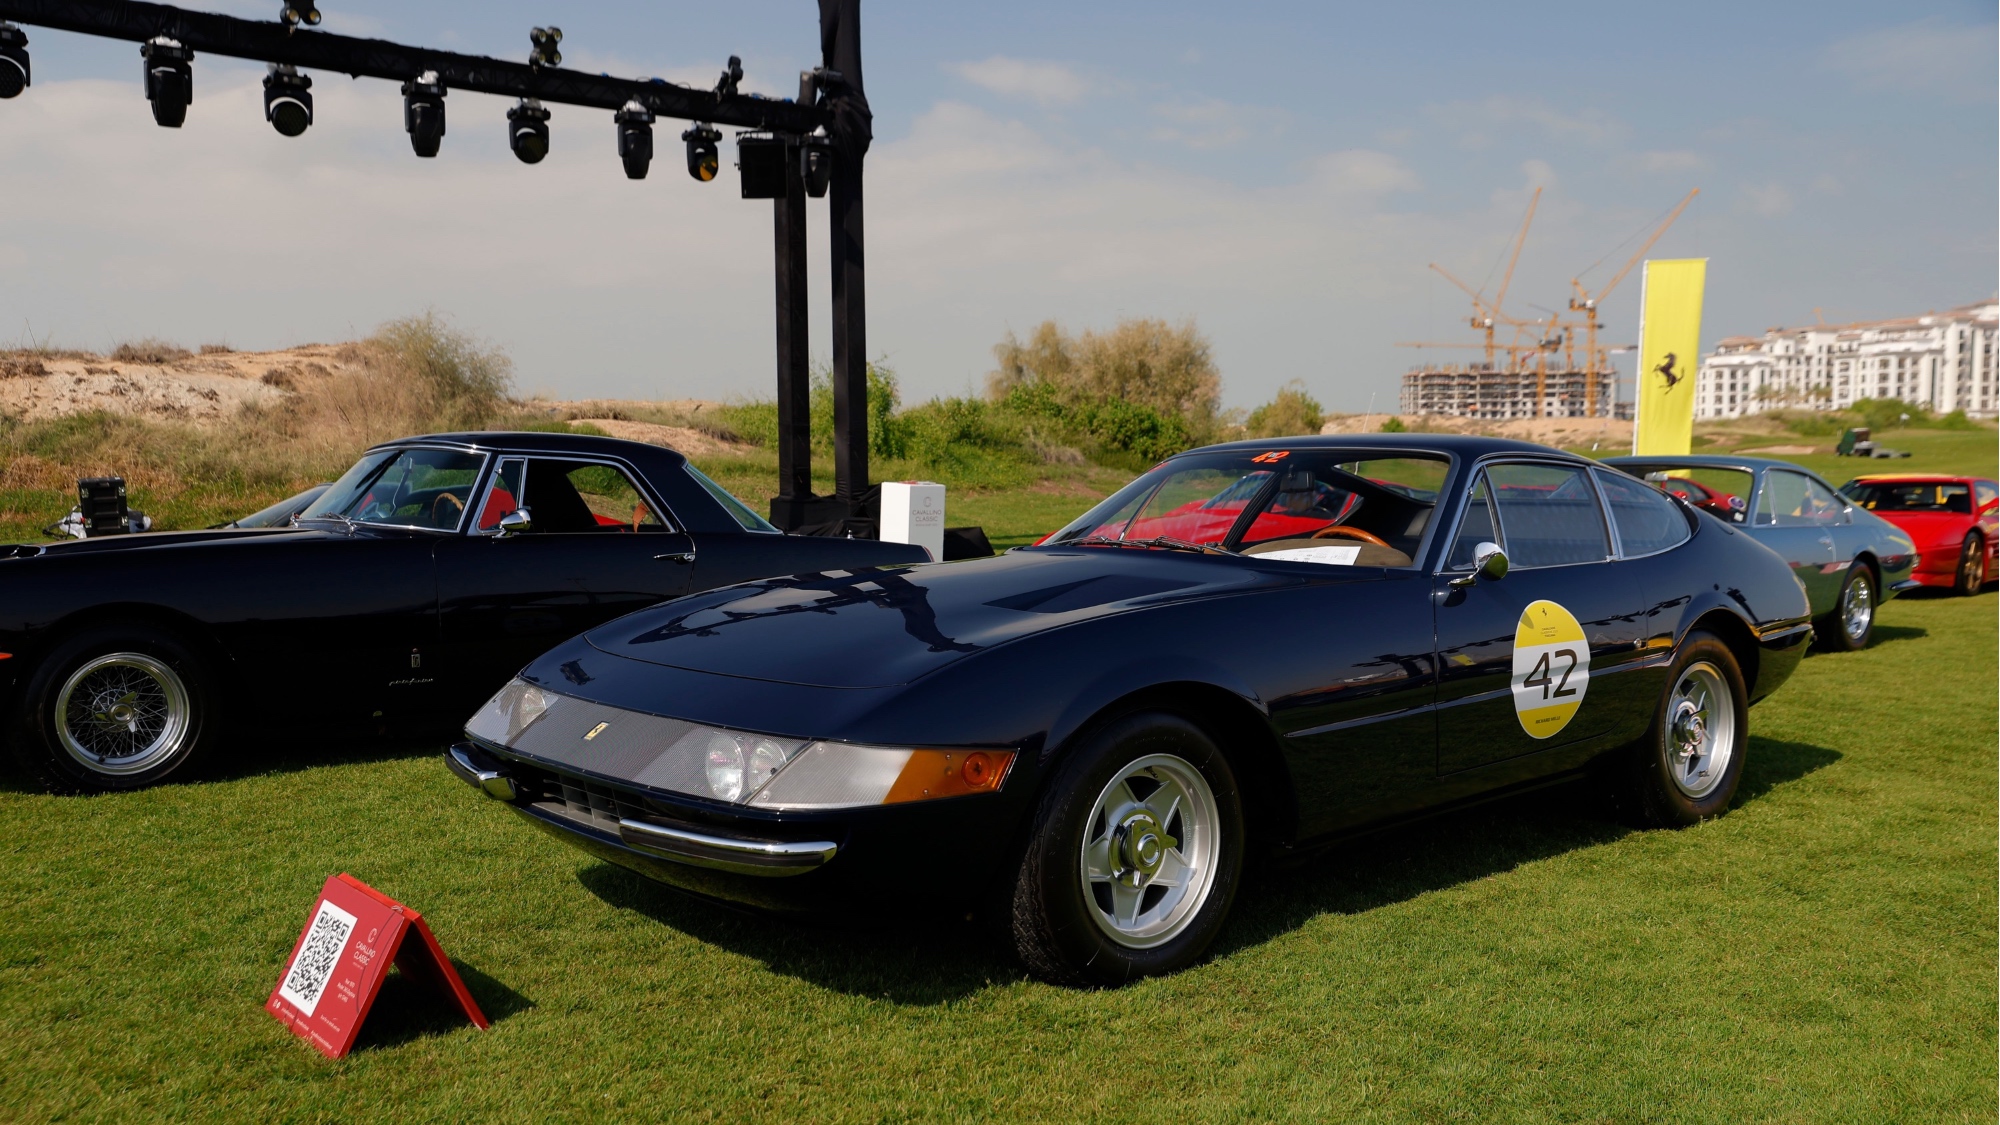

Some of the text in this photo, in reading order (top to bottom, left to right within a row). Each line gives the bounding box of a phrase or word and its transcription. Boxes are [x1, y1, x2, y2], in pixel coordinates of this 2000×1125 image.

[1251, 451, 1290, 463] 42
[1523, 648, 1577, 700] 42
[355, 940, 376, 958] CAVALLINO
[353, 950, 370, 966] CLASSIC
